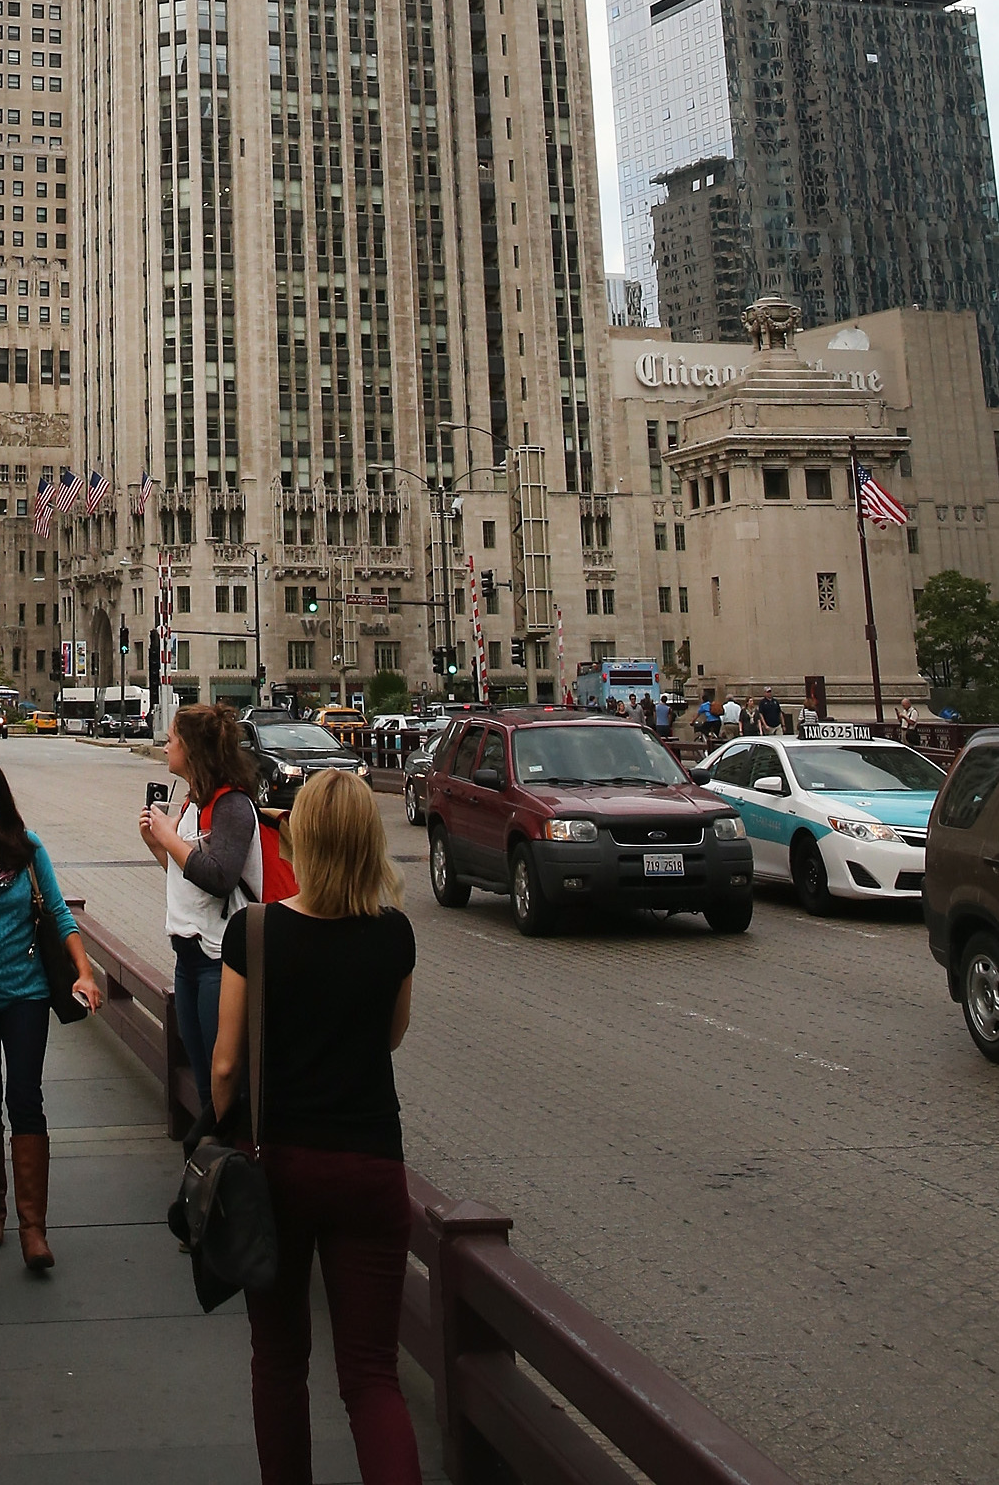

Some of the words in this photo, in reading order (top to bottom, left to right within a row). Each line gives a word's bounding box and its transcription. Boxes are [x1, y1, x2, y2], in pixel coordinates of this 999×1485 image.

[359, 622, 390, 636] Radio
[803, 726, 821, 739] TAXI
[821, 725, 853, 738] 6325
[853, 727, 871, 740] TAXI
[664, 861, 683, 872] 2518
